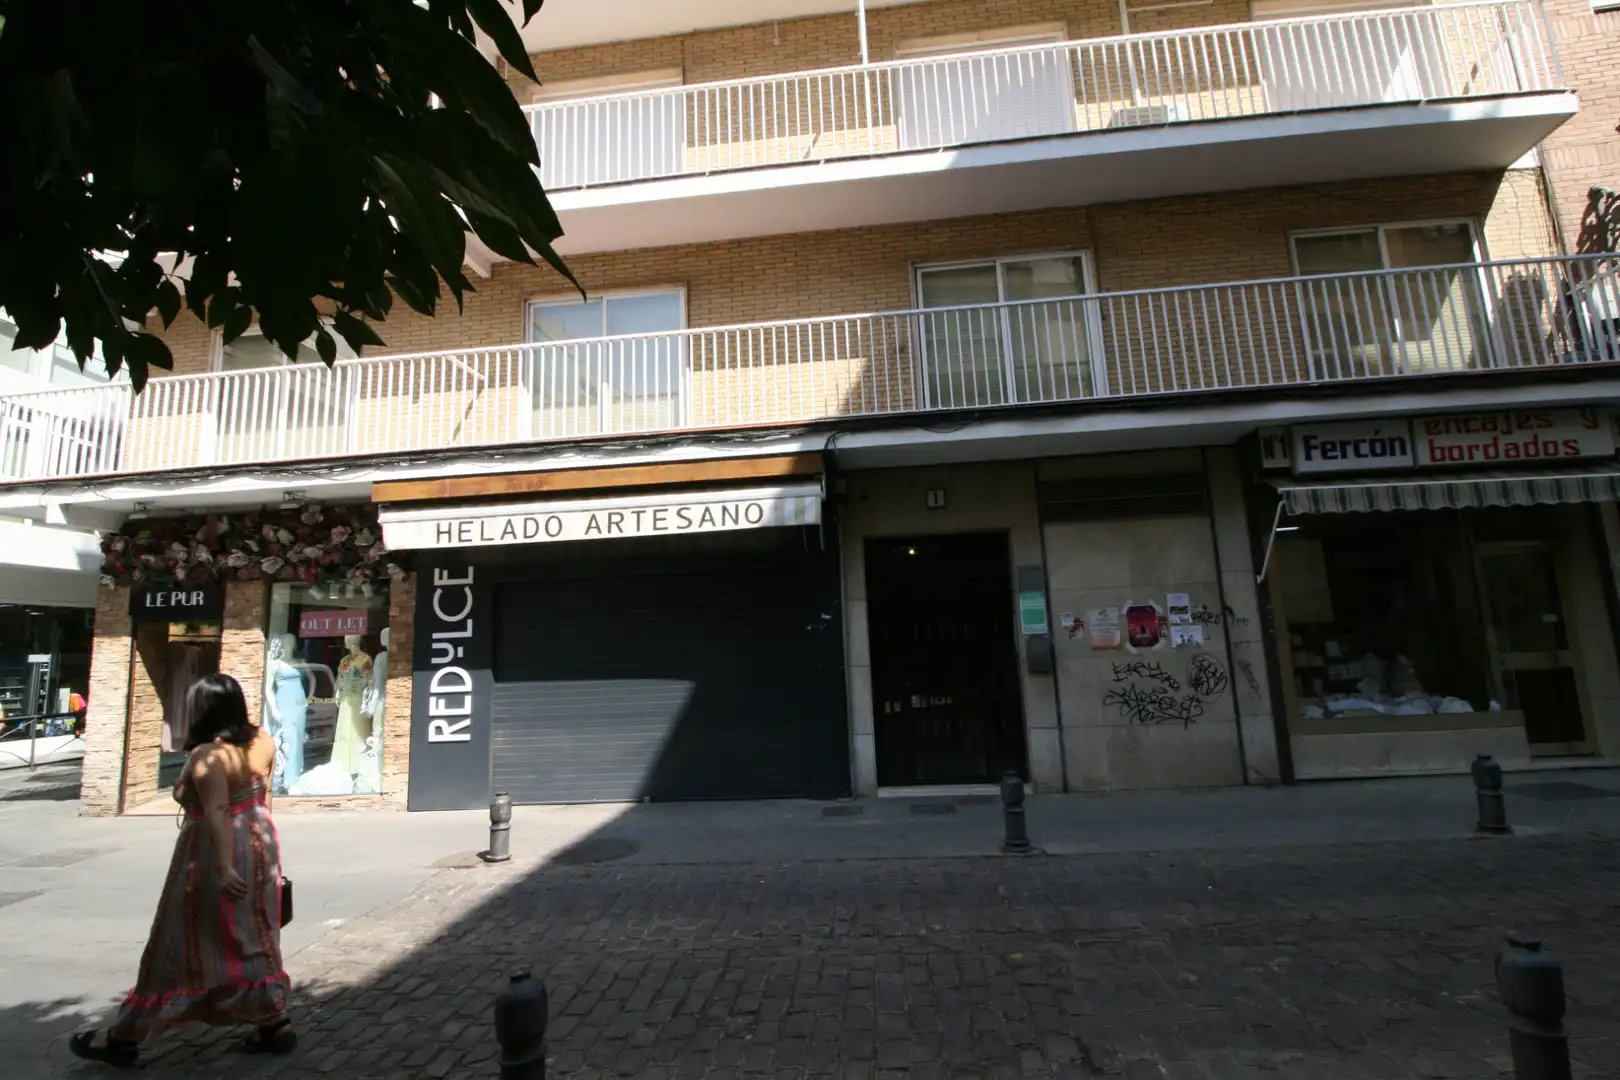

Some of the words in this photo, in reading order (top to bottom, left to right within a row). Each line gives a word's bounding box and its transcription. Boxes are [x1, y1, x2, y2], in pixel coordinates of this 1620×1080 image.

[1303, 429, 1408, 461] Fercón
[1428, 434, 1580, 463] bordados
[436, 515, 562, 544] HELADO
[584, 502, 765, 536] ARTESANO
[145, 591, 167, 607] LE
[170, 590, 204, 607] PUR
